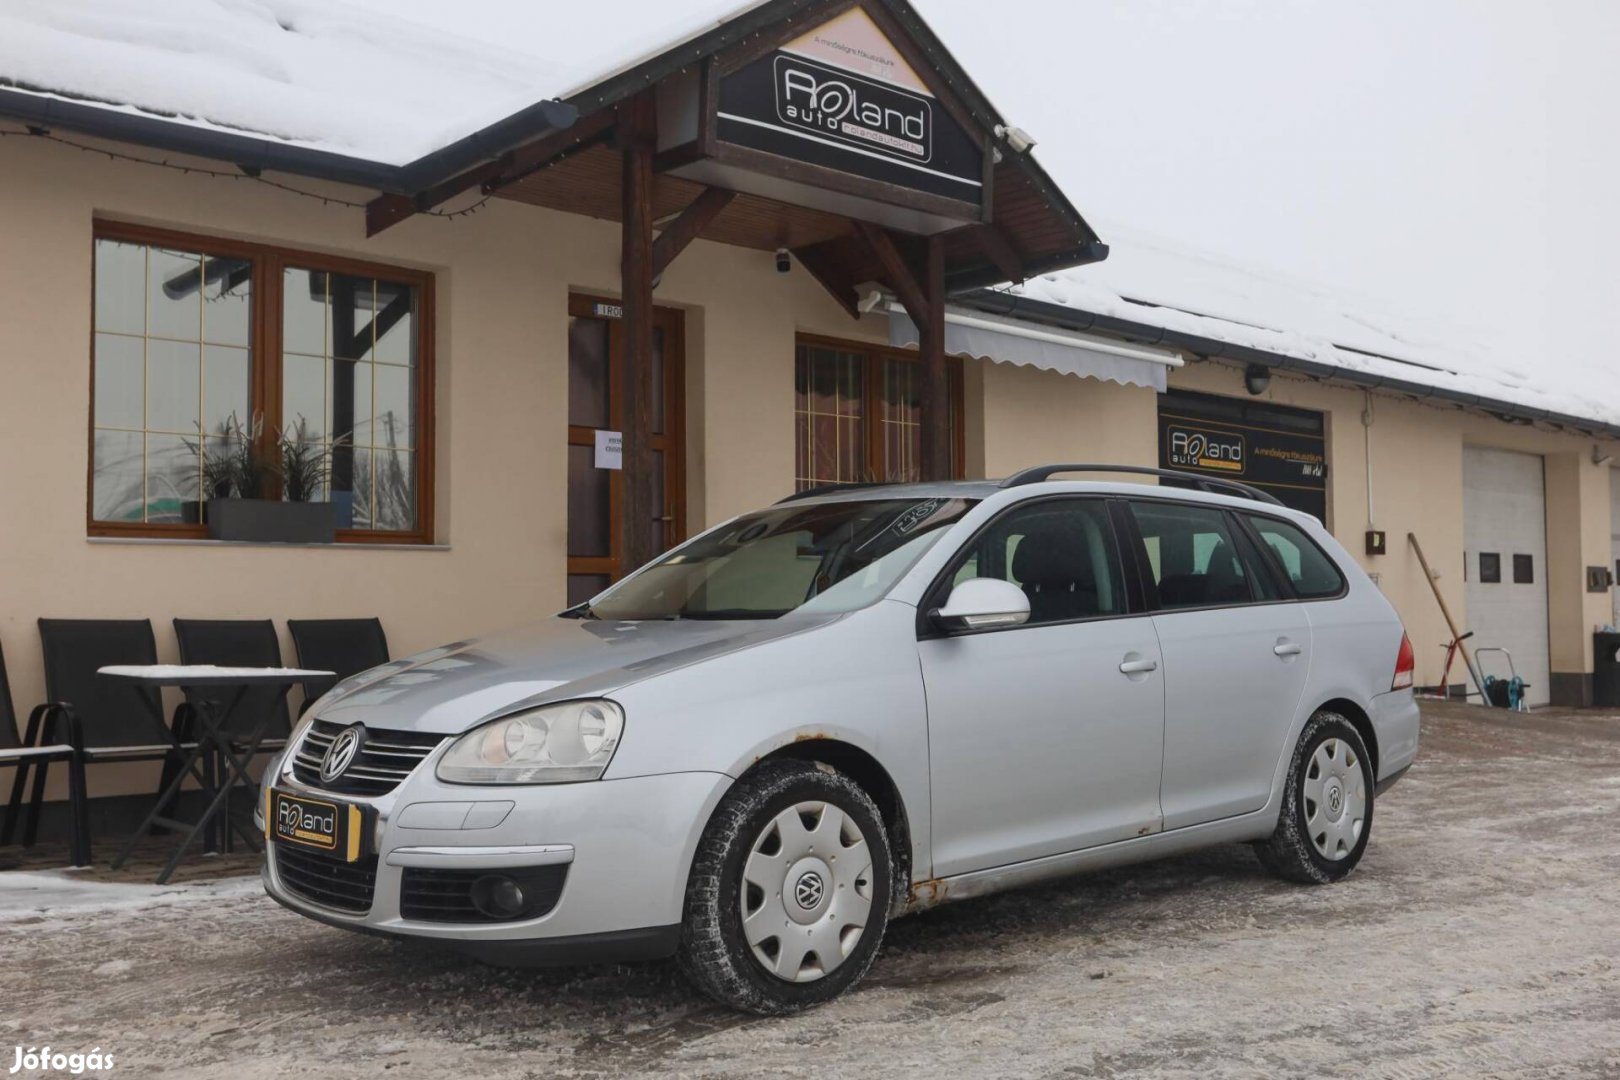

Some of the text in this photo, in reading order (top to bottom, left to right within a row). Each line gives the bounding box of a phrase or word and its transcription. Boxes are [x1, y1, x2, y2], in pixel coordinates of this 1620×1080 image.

[787, 105, 838, 129] auto
[1173, 454, 1198, 465] auto
[279, 824, 295, 835] auto
